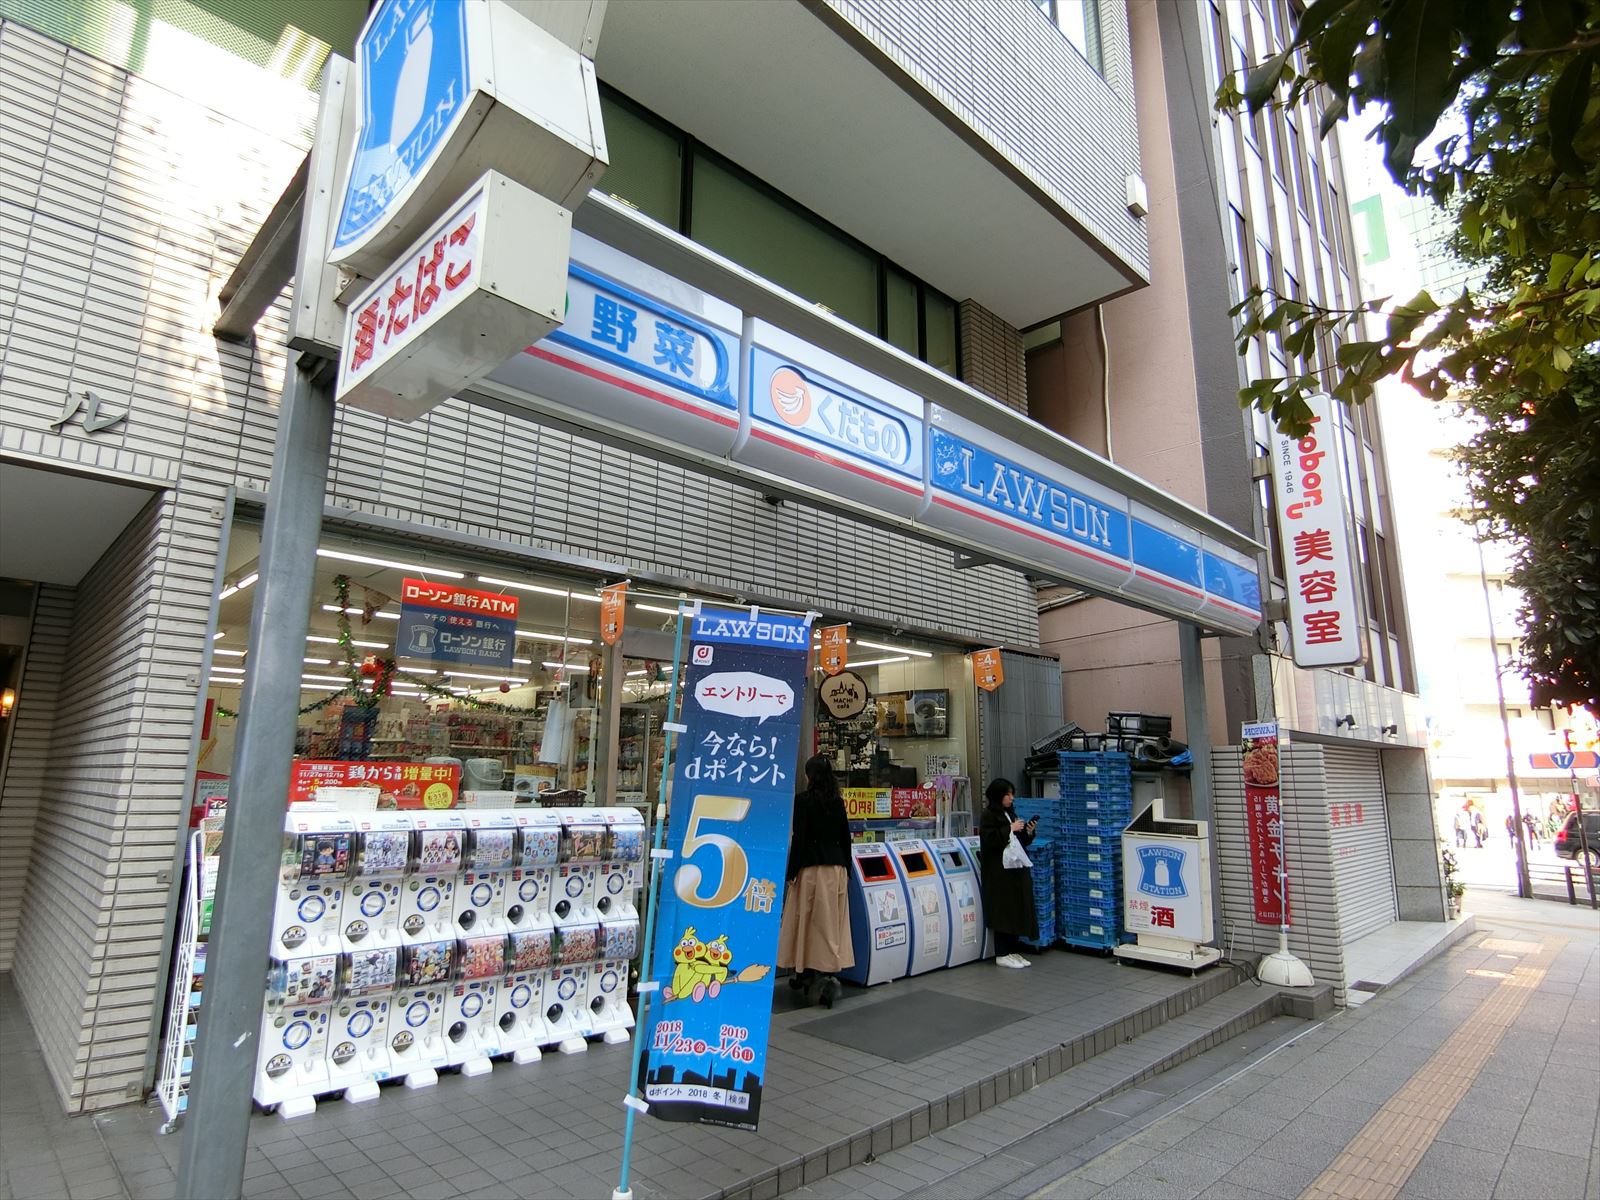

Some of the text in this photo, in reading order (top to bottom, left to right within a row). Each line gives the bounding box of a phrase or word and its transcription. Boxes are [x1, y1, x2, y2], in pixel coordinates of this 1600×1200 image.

[591, 294, 695, 378] 野菜
[50, 391, 129, 433] ル
[817, 394, 899, 459] くだもの
[1281, 440, 1295, 494] SINCE 1946
[961, 449, 1112, 547] LAWSON
[406, 585, 515, 614] ローソン銀行ATM
[1293, 529, 1343, 645] 美容室
[440, 632, 507, 652] ローソン銀行
[697, 617, 806, 644] LAWSON
[702, 686, 787, 705] エントリーで
[701, 730, 777, 760] 今なら!
[684, 757, 786, 787] dポイント
[1554, 753, 1570, 765] 17
[1141, 849, 1182, 861] LAWSON
[1143, 883, 1183, 895] STATION
[1129, 899, 1149, 912] 禁煙
[1151, 905, 1175, 928] 酒
[656, 1021, 747, 1039] 2018 2019
[649, 1087, 683, 1097] dポイント
[688, 1088, 708, 1098] 2018
